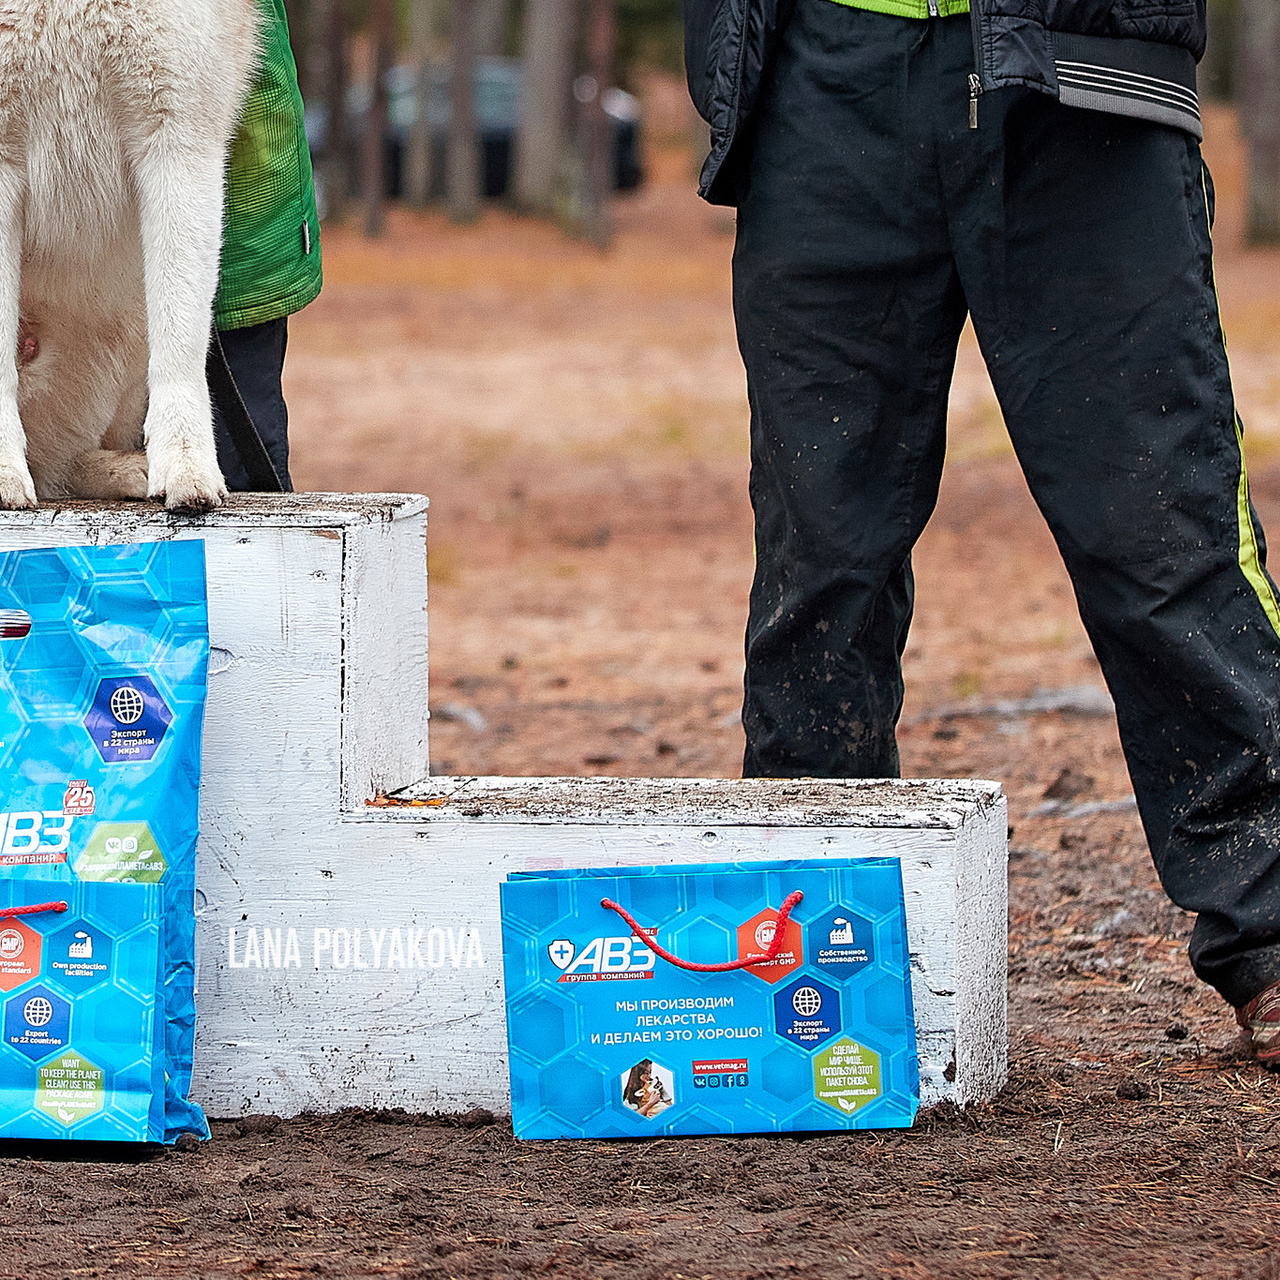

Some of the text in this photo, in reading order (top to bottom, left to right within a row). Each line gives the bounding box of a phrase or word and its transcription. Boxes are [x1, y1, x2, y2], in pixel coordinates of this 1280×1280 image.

[111, 729, 147, 739] Экспорт
[111, 738, 122, 747] 22
[123, 738, 155, 747] страны
[117, 747, 140, 756] мира
[66, 787, 94, 807] 25
[2, 853, 56, 865] компаний
[565, 936, 658, 973] АВЗ
[819, 949, 866, 957] Собственное
[818, 956, 868, 964] производство
[69, 963, 107, 971] production
[65, 969, 94, 977] facilities
[566, 971, 645, 982] группа компаний
[616, 997, 734, 1011] МЫ ПРОИЗВОДИМ
[636, 1014, 716, 1027] ЛЕКАРСТВА
[793, 1020, 823, 1028] Экспорт
[25, 1030, 48, 1038] Export
[804, 1026, 830, 1034] страны
[591, 1027, 763, 1045] И ДЕЛАЕМ ЭТО ХОРОШО!
[30, 1037, 62, 1045] countries
[694, 1062, 747, 1071] www.vetmag.ru
